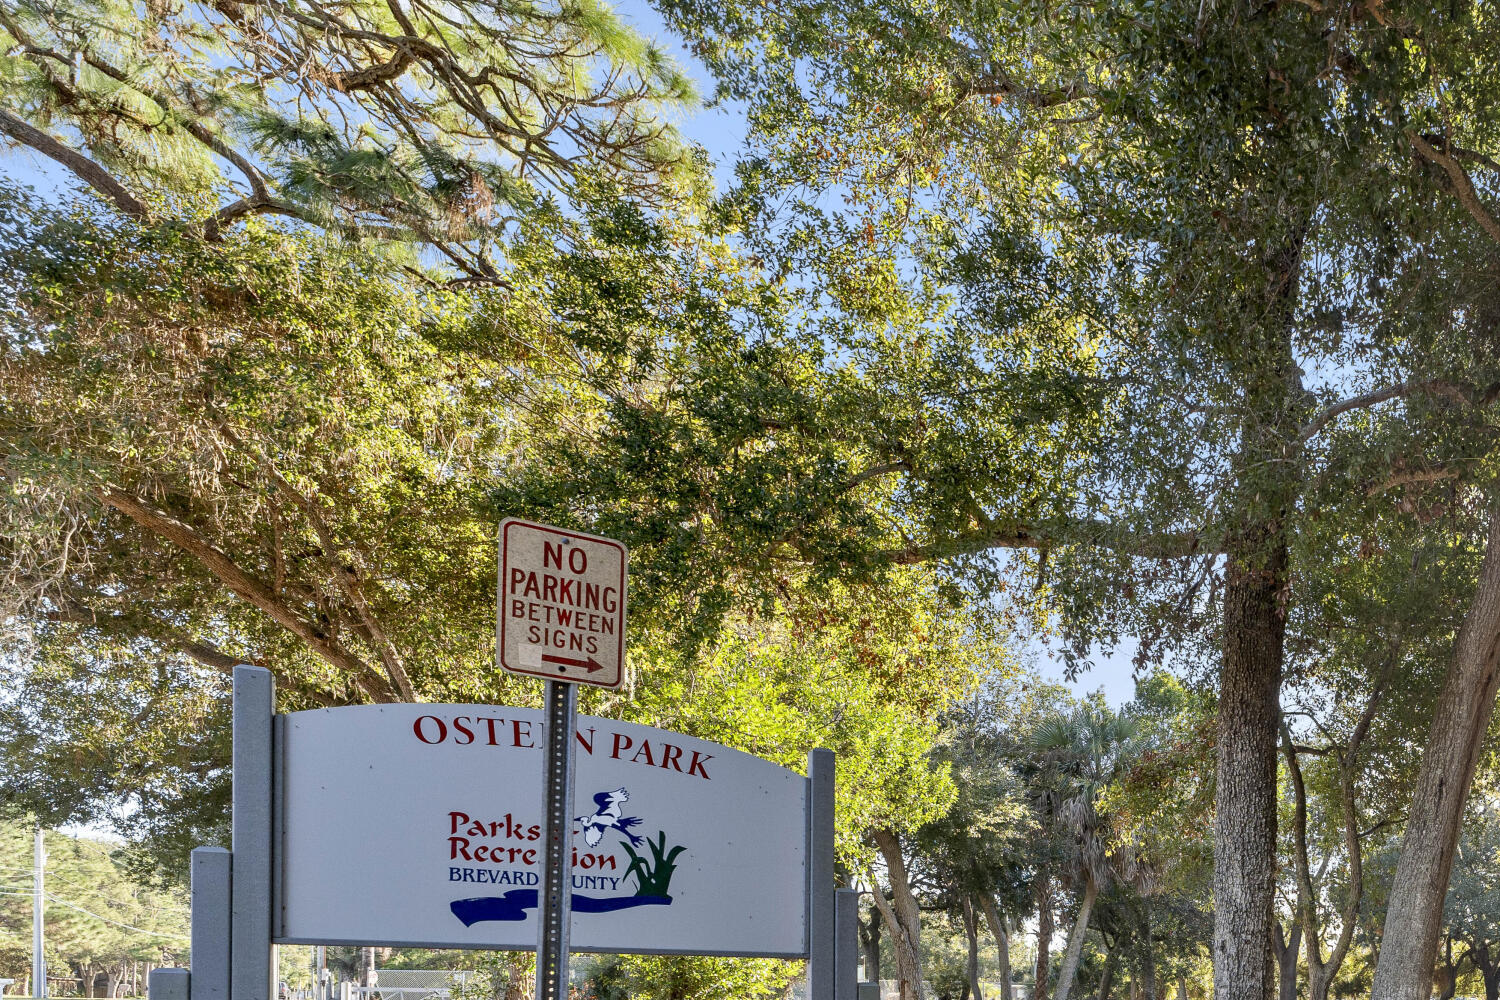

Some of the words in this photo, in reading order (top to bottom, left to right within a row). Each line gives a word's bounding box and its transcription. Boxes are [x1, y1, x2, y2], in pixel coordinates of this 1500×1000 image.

[543, 541, 588, 574] NO
[510, 567, 617, 613] PARKING
[511, 600, 614, 635] BETWEEN
[527, 625, 598, 654] SIGNS
[413, 715, 596, 756] OSTEN
[608, 732, 715, 780] PARK
[448, 811, 541, 841] Parks
[447, 836, 617, 870] Recreion
[448, 867, 539, 886] BREVARD
[572, 874, 620, 890] UNTY
